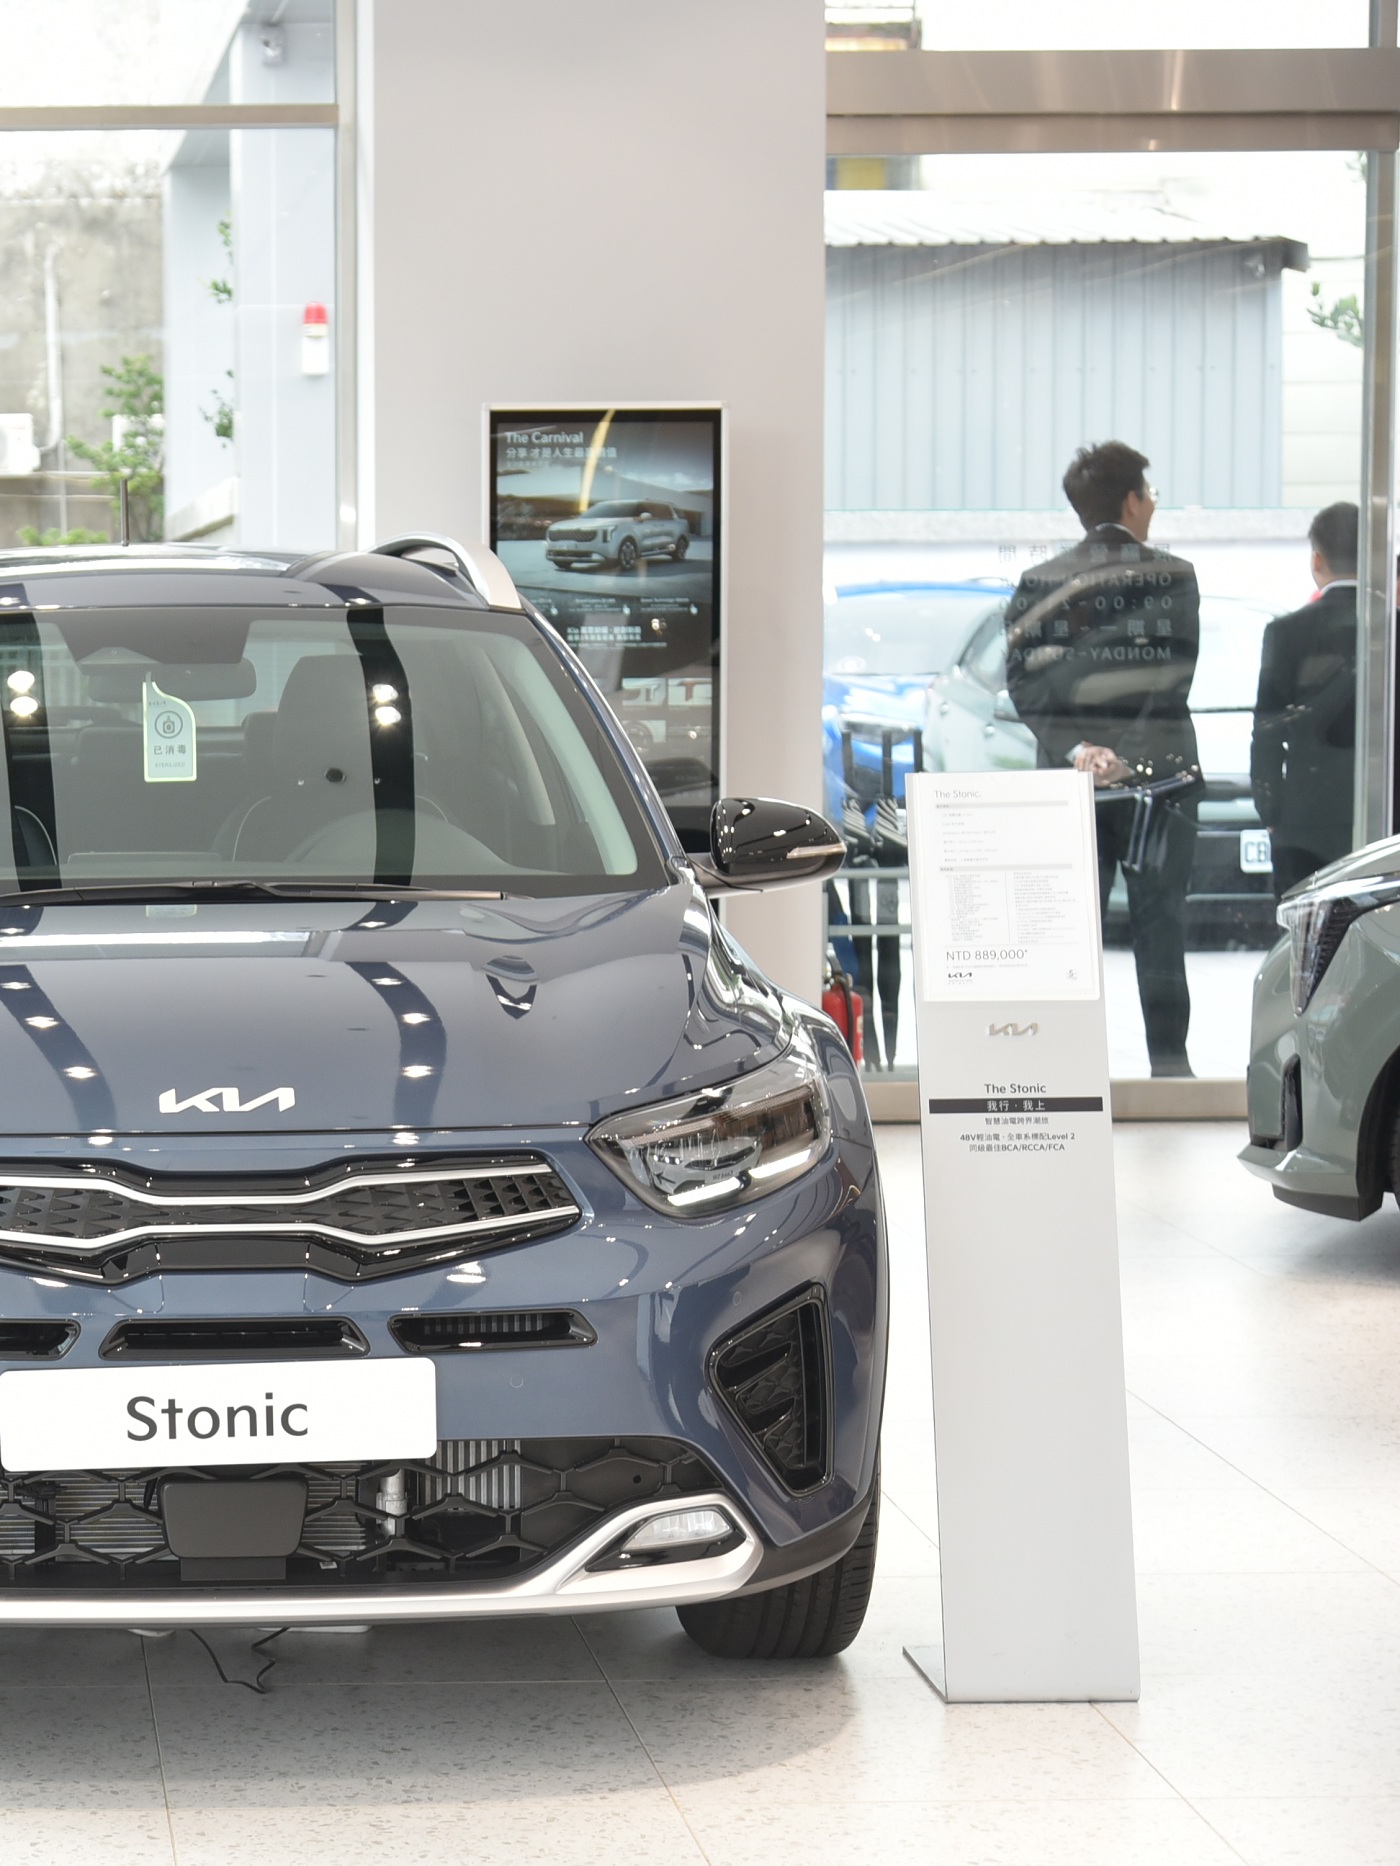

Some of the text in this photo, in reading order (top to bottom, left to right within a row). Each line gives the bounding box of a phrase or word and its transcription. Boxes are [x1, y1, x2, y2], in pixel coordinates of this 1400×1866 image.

[506, 431, 584, 444] The Carnival
[505, 447, 528, 458] 分享
[153, 744, 188, 756] 已消毒
[934, 790, 951, 799] The
[1244, 841, 1271, 863] CB
[946, 950, 972, 961] NTD
[988, 1022, 1039, 1037] KIA
[984, 1082, 1047, 1094] The Stonic
[158, 1087, 296, 1114] KIA
[126, 1392, 309, 1442] Stonic
